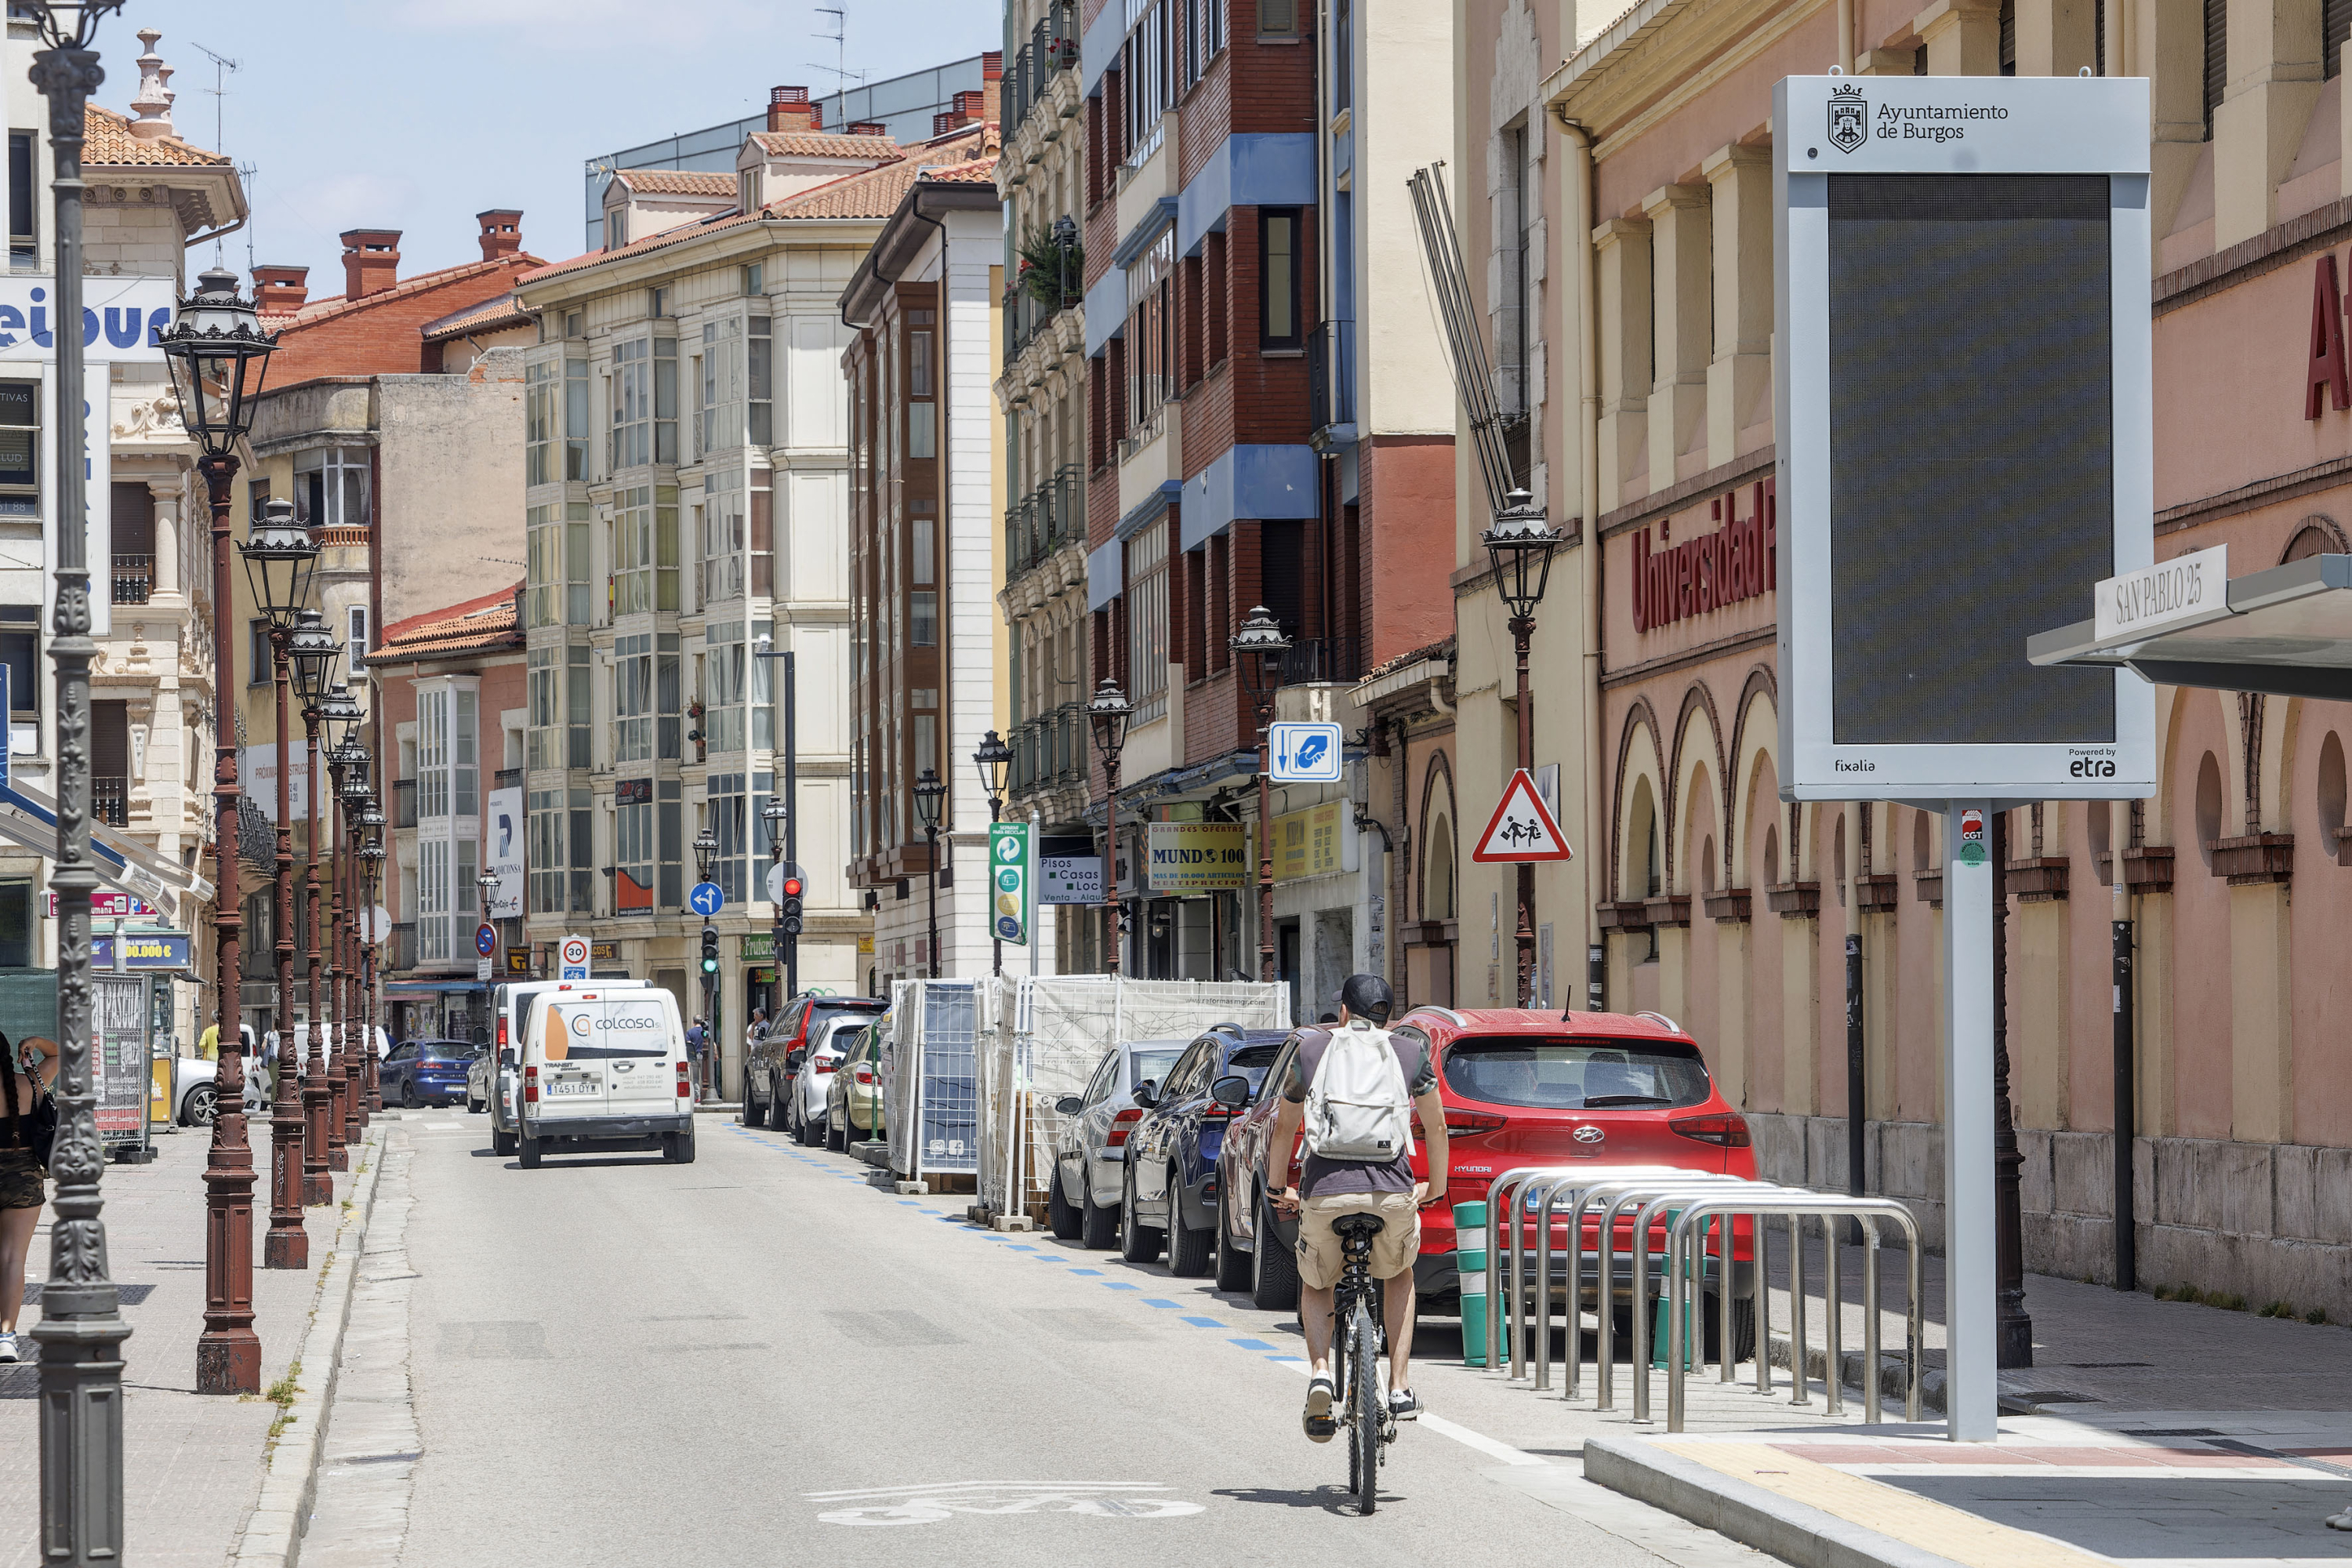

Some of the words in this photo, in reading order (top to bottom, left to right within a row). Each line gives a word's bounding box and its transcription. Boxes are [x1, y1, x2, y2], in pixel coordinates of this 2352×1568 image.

[1877, 103, 2009, 124] Ayuntamiento
[1876, 122, 1898, 139] de
[1903, 122, 1964, 143] Burgos
[0, 453, 23, 463] LUD
[1631, 481, 1764, 633] Universidad
[2116, 579, 2140, 625] SAN
[2143, 567, 2183, 618] PABLO
[2187, 561, 2202, 606] 25
[2106, 749, 2116, 757] by
[2069, 757, 2116, 778] etra
[1963, 831, 1982, 840] CGT
[1221, 848, 1245, 863] 100
[1041, 858, 1072, 868] Pisos
[1060, 869, 1098, 879] Casas
[1076, 881, 1102, 891] Loc
[568, 948, 583, 956] 30
[591, 946, 606, 955] COS
[595, 1017, 655, 1030] colcasa
[554, 1084, 575, 1094] 1451
[579, 1083, 596, 1093] DYW
